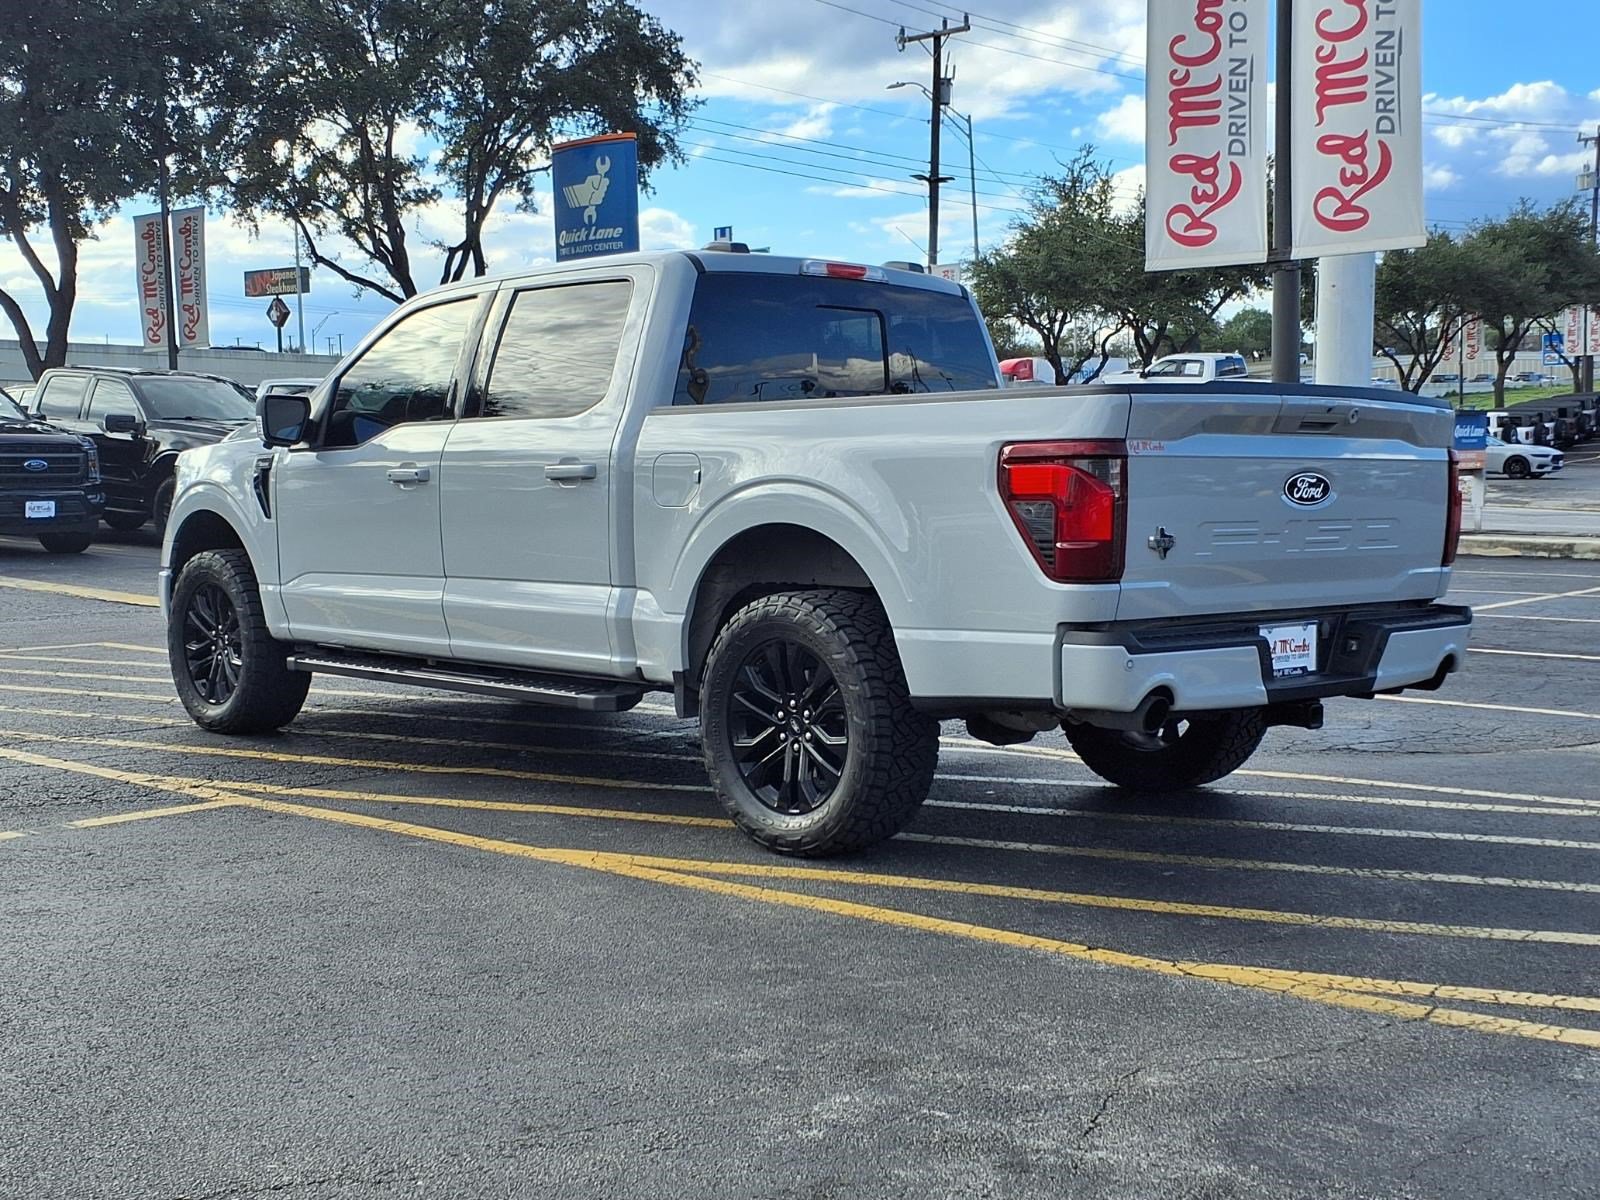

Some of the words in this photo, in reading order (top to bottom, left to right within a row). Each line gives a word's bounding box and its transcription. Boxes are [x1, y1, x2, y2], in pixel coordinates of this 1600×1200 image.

[1229, 12, 1248, 49] TO
[1375, 30, 1396, 135] DRIVEN
[1228, 58, 1248, 157] DRIVEN
[1166, 150, 1242, 248] Red
[1313, 129, 1392, 232] Red
[559, 228, 589, 246] Quick
[589, 226, 624, 240] Lane
[576, 244, 593, 254] AUTO
[593, 241, 624, 252] CENTER
[141, 221, 159, 305] McCombs
[157, 254, 164, 269] TO
[178, 216, 194, 300] McCombs
[192, 251, 200, 263] TO
[158, 271, 166, 310] DRIVEN
[192, 267, 200, 306] DRIVEN
[146, 307, 165, 343] Red
[182, 303, 200, 341] Red
[1455, 425, 1471, 438] Quick
[1471, 425, 1485, 437] Lane
[1293, 477, 1324, 499] Ford
